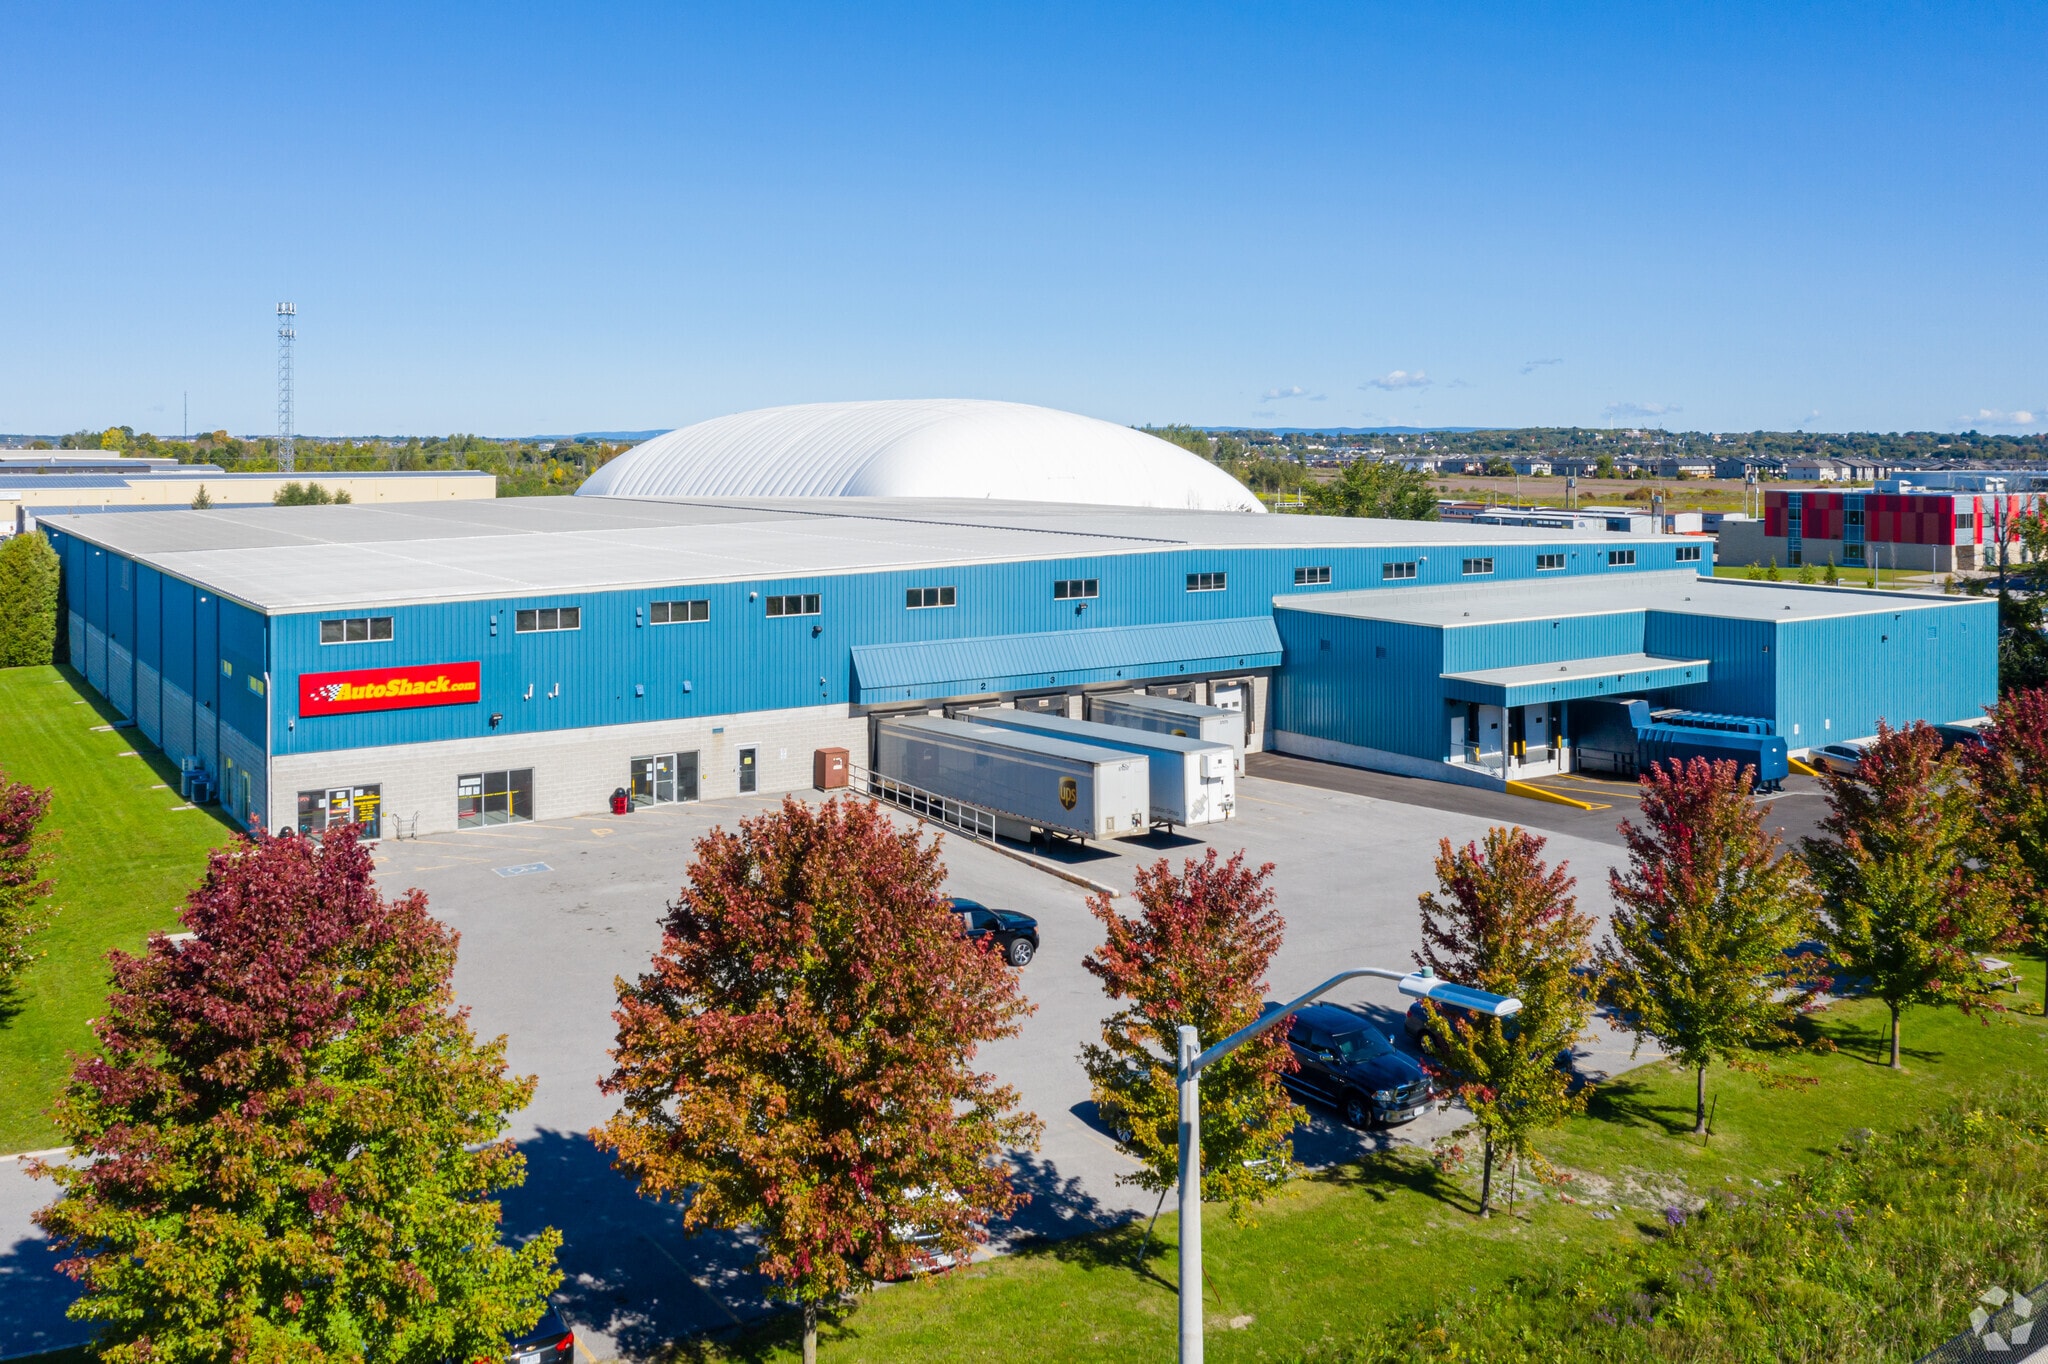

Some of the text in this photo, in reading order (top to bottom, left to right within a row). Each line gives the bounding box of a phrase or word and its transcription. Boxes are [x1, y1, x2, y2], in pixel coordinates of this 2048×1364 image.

[1239, 658, 1245, 666] 6
[1179, 664, 1185, 672] 5
[1116, 670, 1122, 678] 4
[1050, 676, 1056, 684] 3
[333, 675, 476, 702] AutoShack.com
[980, 682, 986, 690] 2
[906, 689, 911, 697] 1
[1551, 687, 1557, 695] 7
[1060, 786, 1076, 807] ups
